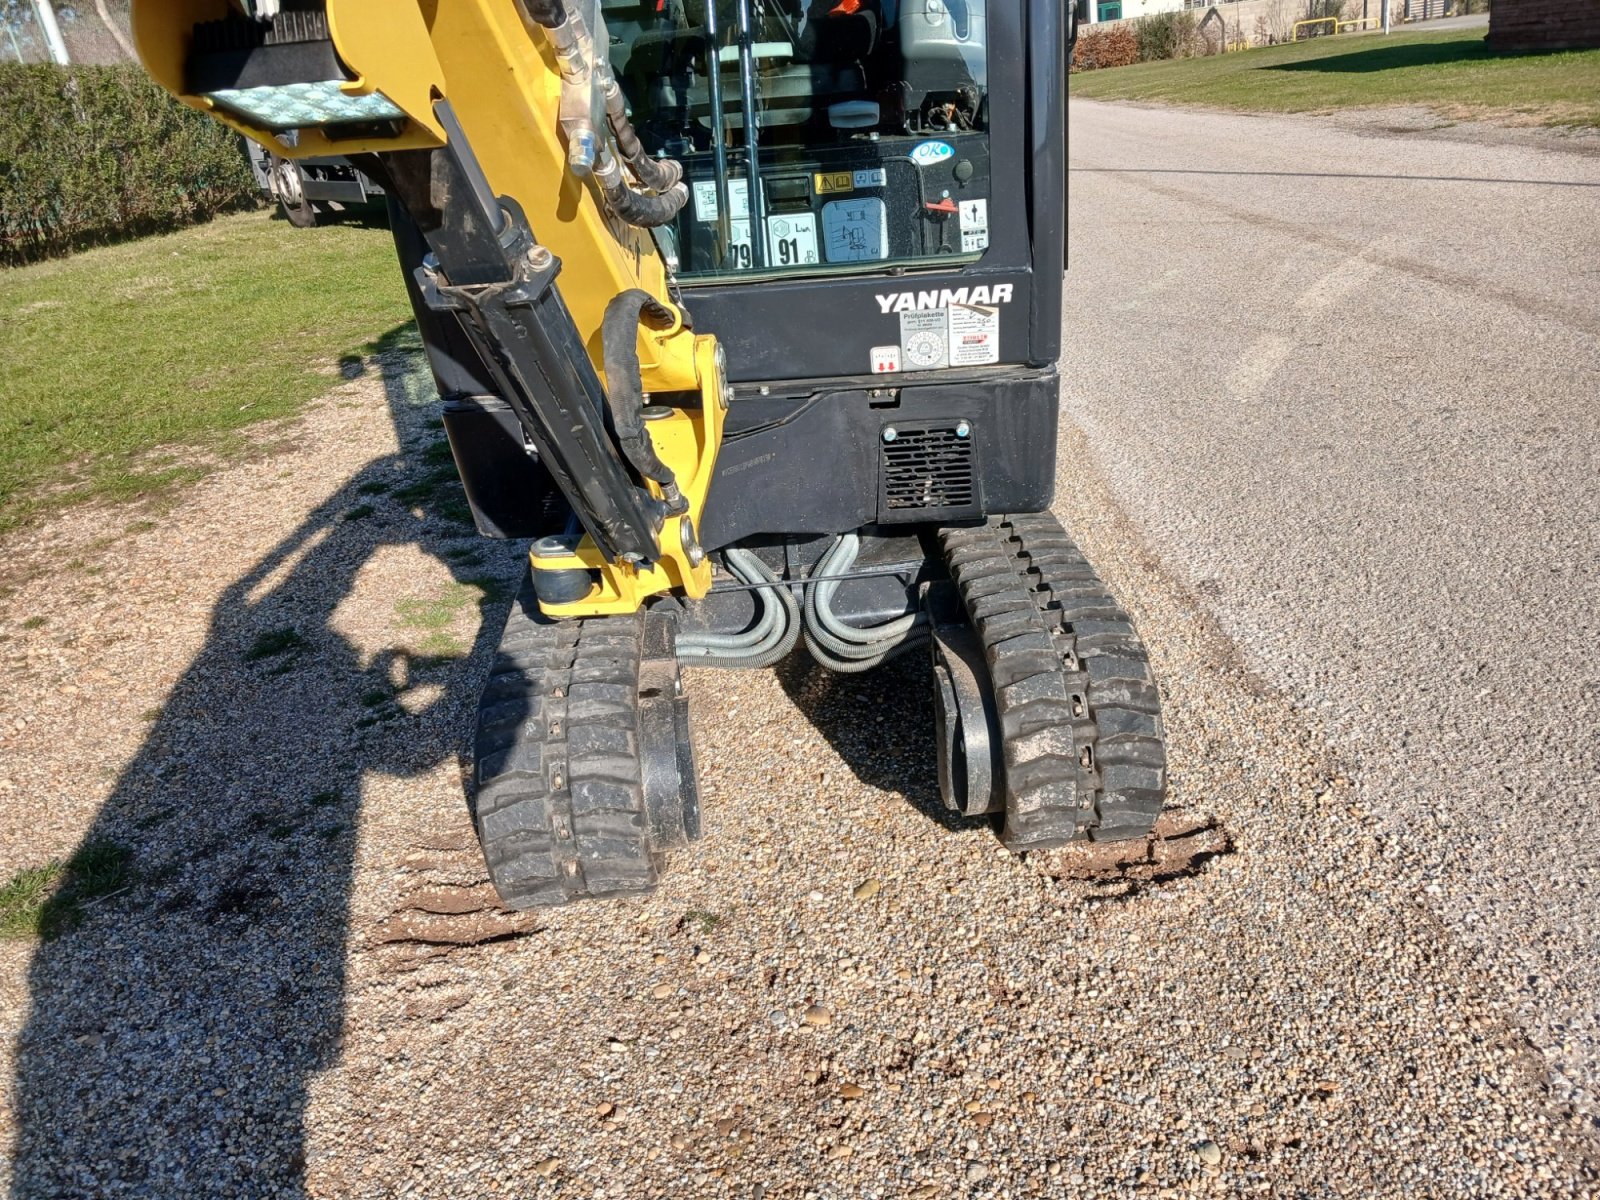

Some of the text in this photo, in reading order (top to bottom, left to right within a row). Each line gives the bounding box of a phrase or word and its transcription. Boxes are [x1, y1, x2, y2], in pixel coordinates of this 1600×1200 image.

[778, 238, 799, 265] 91
[875, 284, 1013, 314] YANMAR
[903, 311, 945, 319] Prüfplakette
